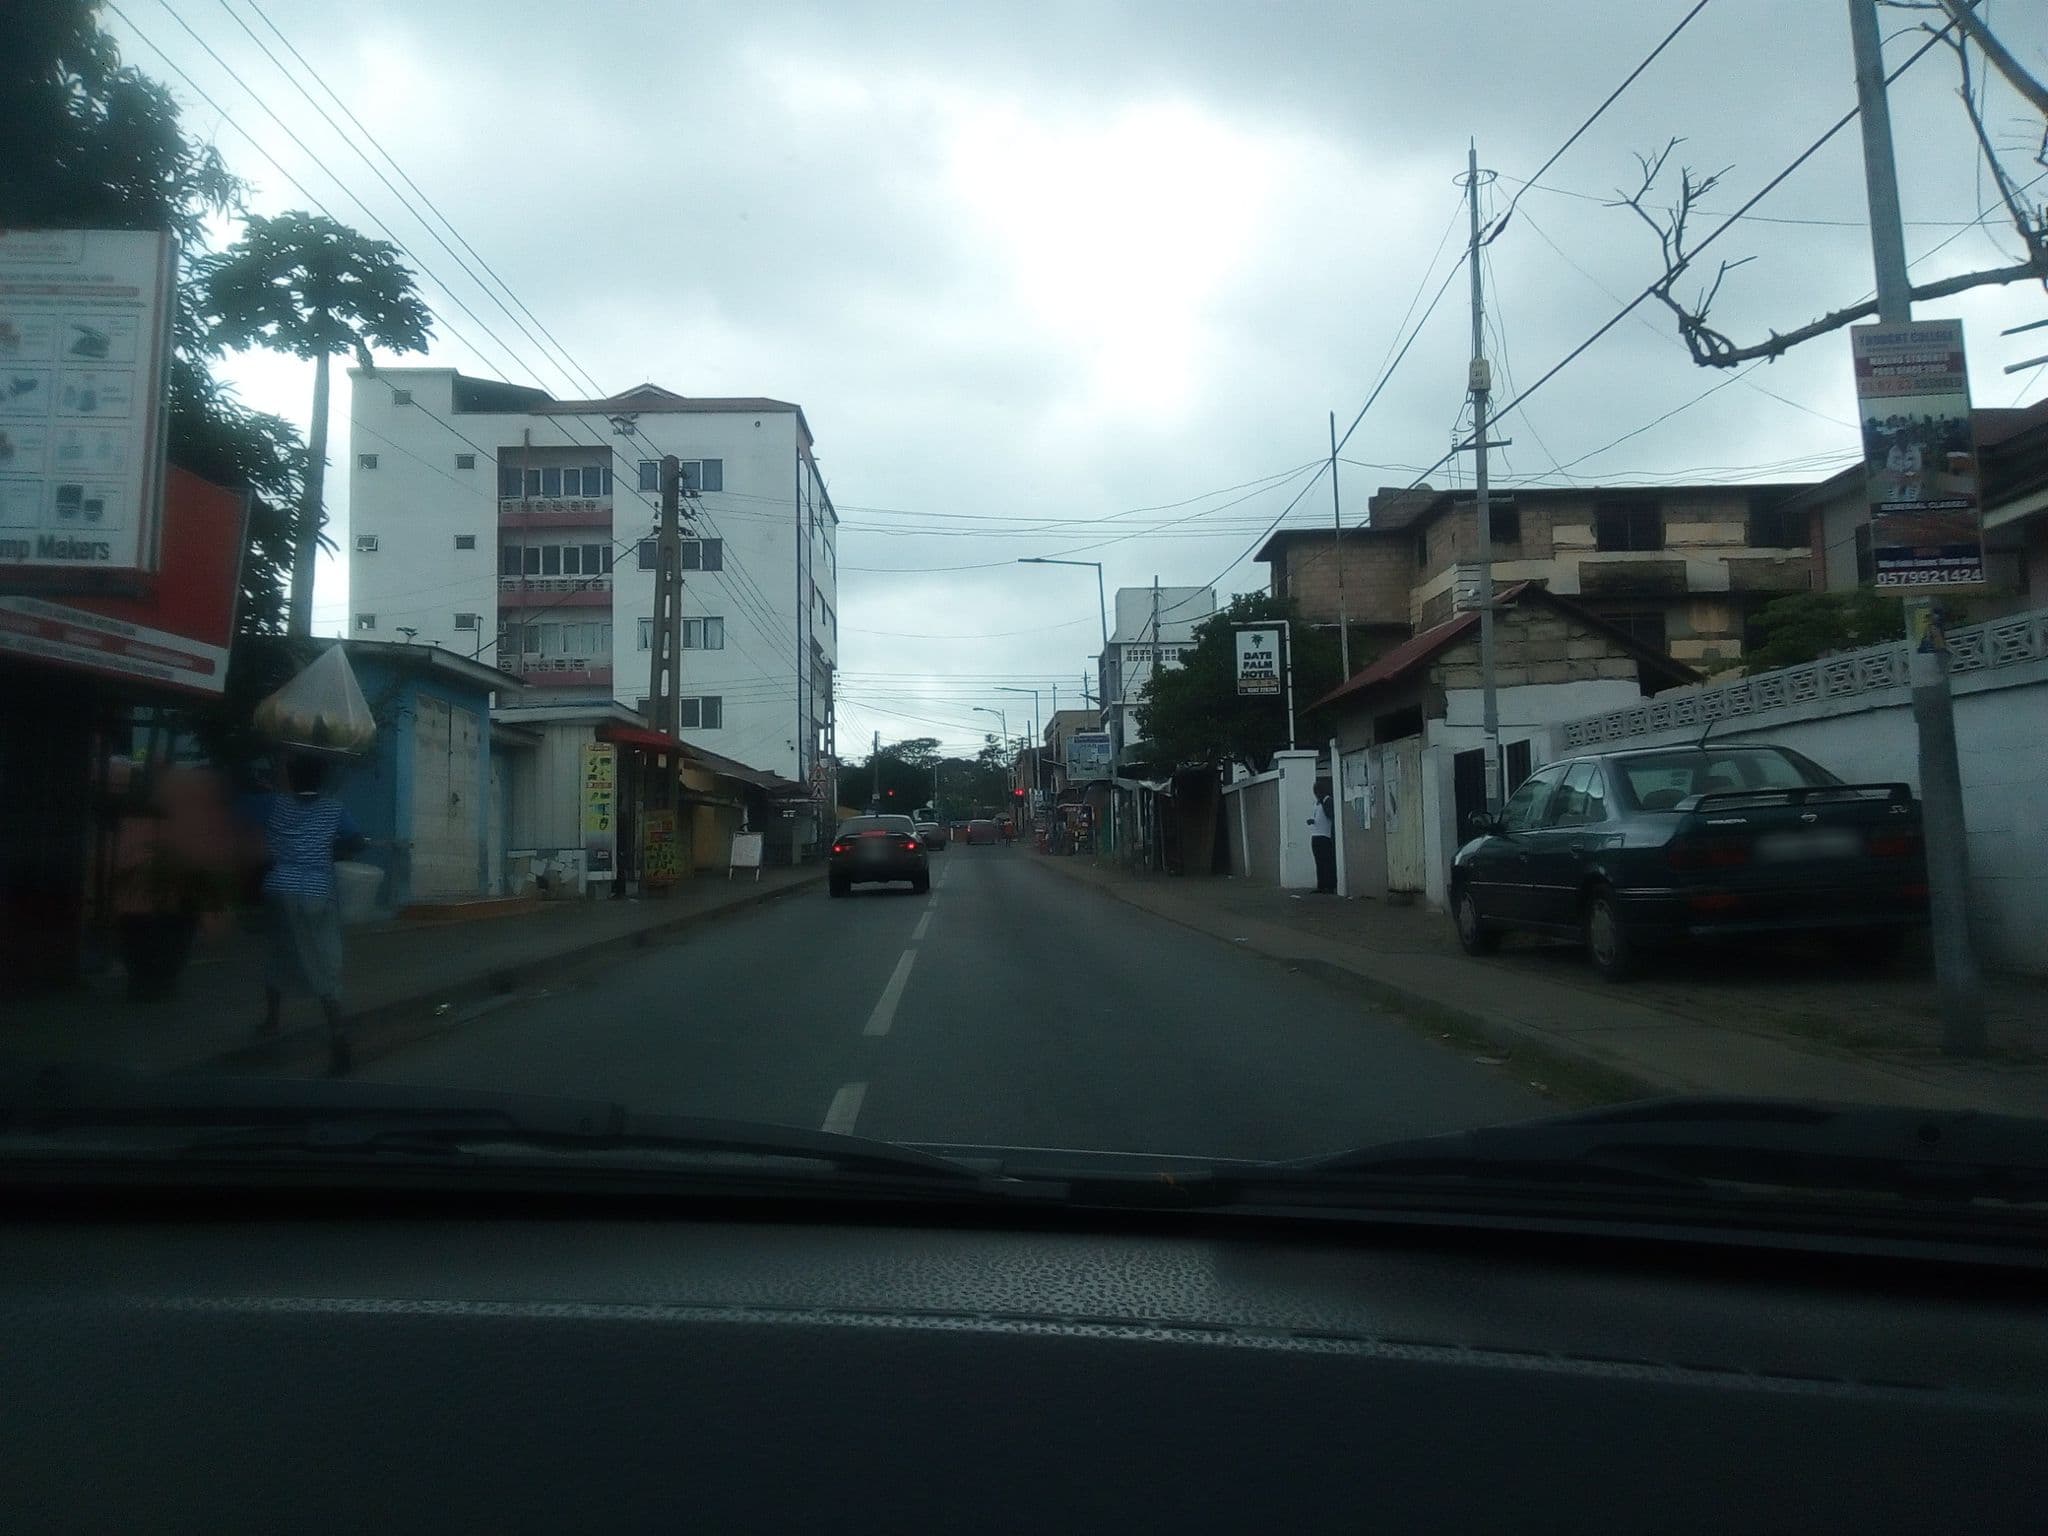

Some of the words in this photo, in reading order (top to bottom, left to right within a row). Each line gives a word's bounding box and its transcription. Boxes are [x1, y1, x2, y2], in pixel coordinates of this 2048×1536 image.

[37, 534, 110, 560] Makers
[1877, 569, 1982, 584] 0579921424
[1244, 651, 1272, 660] DATE
[1243, 661, 1273, 669] PALM
[1241, 670, 1275, 679] HOTEL
